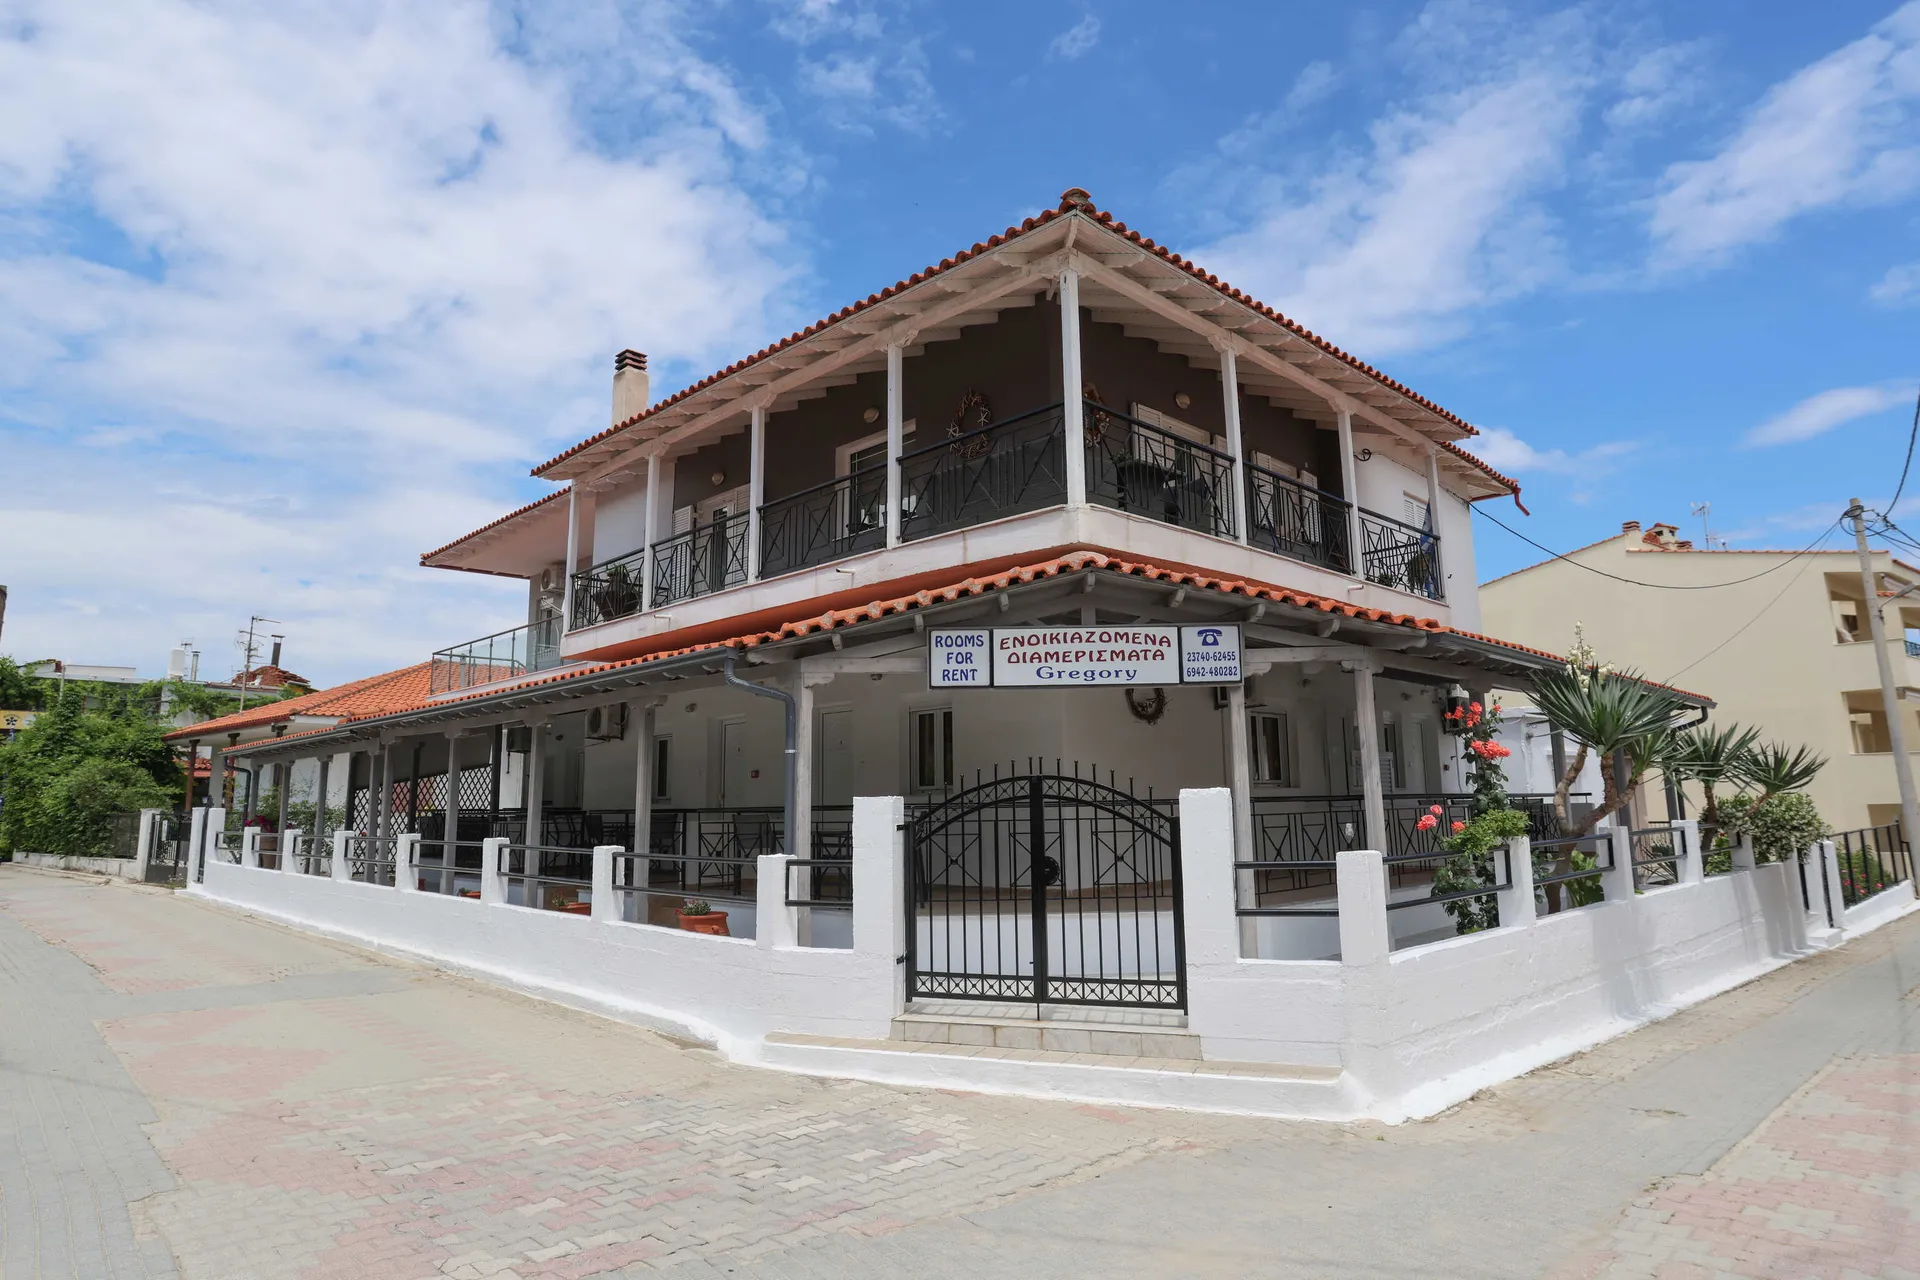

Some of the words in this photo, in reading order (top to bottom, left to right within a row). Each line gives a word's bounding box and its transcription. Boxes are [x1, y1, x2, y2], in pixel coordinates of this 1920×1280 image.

[935, 634, 984, 648] ROOMS
[1000, 631, 1171, 650] ΕΝΟΙΚΙΑΖΟΜΕΝΑ
[946, 652, 973, 664] FOR
[1007, 649, 1165, 663] ΔΙΑΜΕΡΙΣΜΑΤΑ
[942, 669, 978, 681] RENT
[1036, 666, 1137, 681] Gregory
[1186, 666, 1238, 677] 6942-480282
